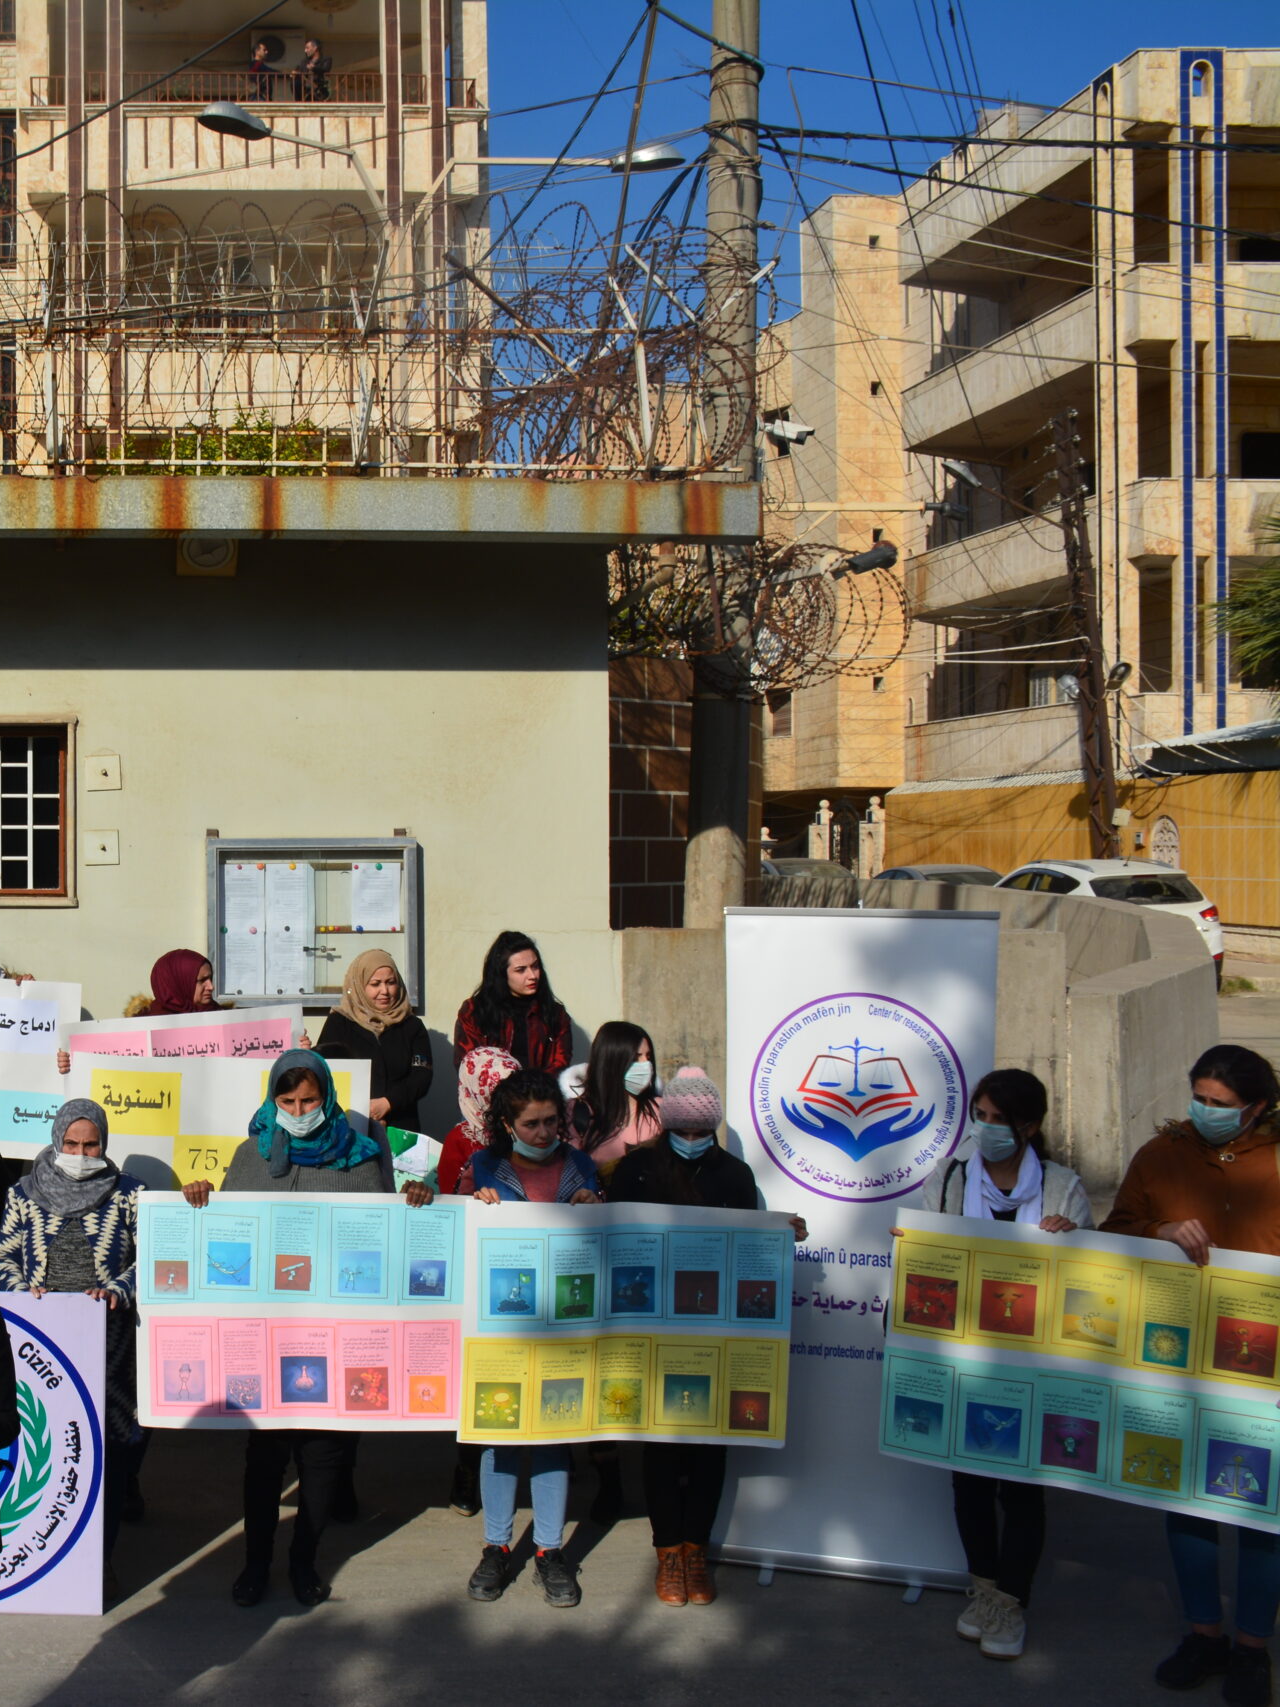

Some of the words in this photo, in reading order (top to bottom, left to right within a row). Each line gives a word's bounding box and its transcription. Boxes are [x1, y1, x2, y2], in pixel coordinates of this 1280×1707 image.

[802, 1006, 835, 1026] mafên
[837, 1003, 851, 1017] jin
[868, 1004, 891, 1018] Center
[892, 1009, 902, 1022] for
[19, 1017, 56, 1035] ادماج
[903, 1017, 931, 1041] research
[231, 1037, 261, 1056] تعزيز
[262, 1038, 284, 1054] يجب
[767, 1022, 802, 1067] parastina
[926, 1037, 940, 1052] and
[934, 1050, 956, 1085] protection
[102, 1085, 171, 1115] السنوية
[944, 1094, 956, 1126] women's
[12, 1103, 58, 1123] توسيع
[764, 1114, 796, 1160] Navenda
[936, 1126, 951, 1146] rights
[915, 1150, 935, 1165] Syria
[931, 1144, 941, 1153] in
[188, 1148, 219, 1171] 75
[797, 1157, 816, 1174] المرأة
[813, 1169, 834, 1182] حقوق
[894, 1166, 912, 1182] مركز
[839, 1248, 847, 1264] û
[850, 1251, 892, 1269] parast
[789, 1343, 806, 1355] arch
[807, 1344, 823, 1356] and
[824, 1345, 865, 1359] protection
[866, 1347, 875, 1361] of
[17, 1341, 63, 1390] Cizîrê
[64, 1420, 81, 1464] منظمة
[57, 1466, 79, 1504] حقوق
[31, 1501, 68, 1551] الإنسان
